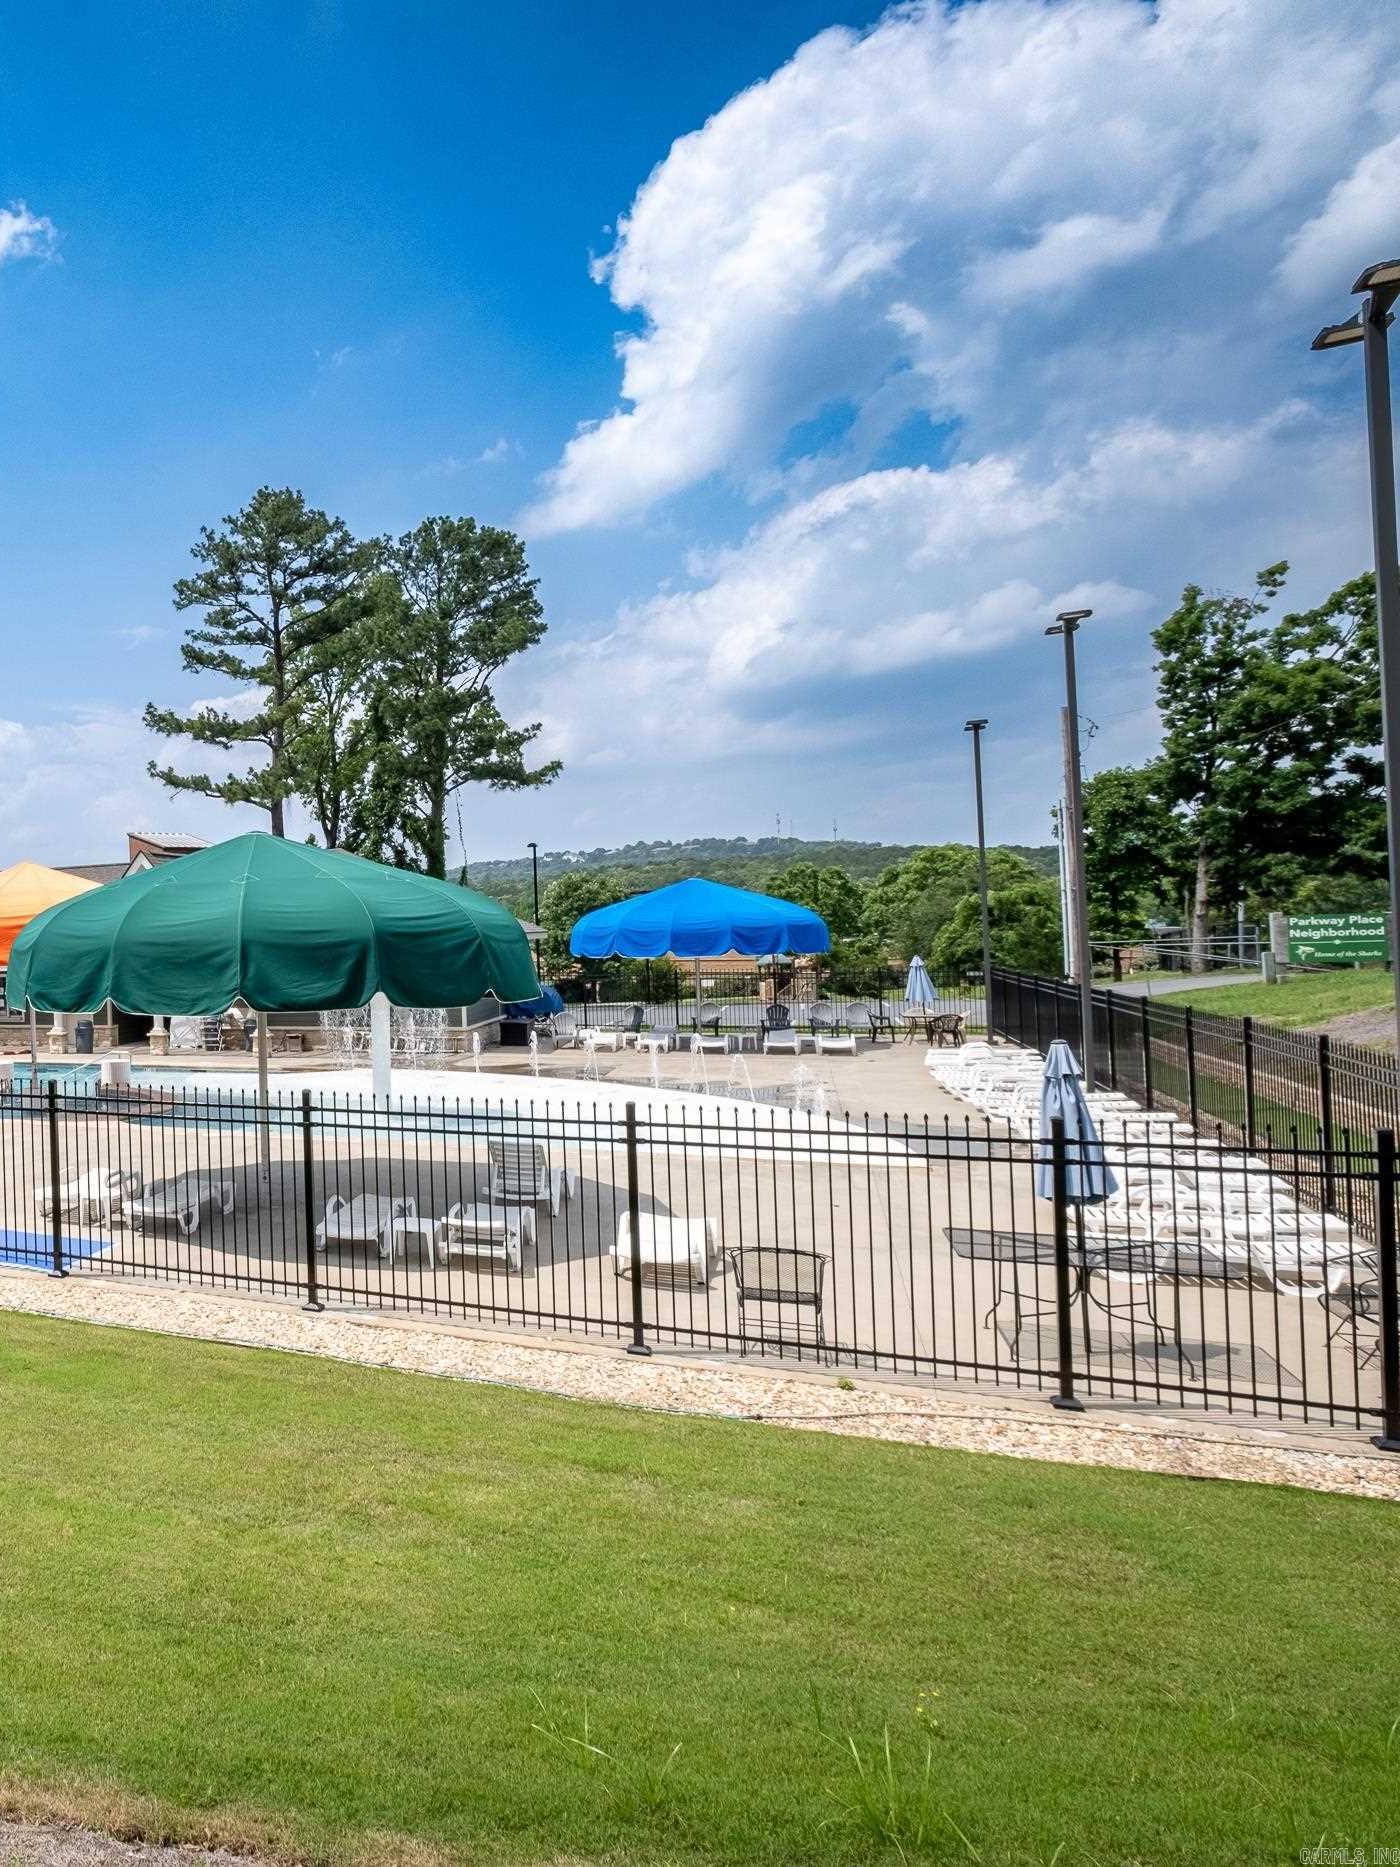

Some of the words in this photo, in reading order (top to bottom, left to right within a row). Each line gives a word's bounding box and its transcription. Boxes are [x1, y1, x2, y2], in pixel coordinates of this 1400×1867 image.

[1289, 917, 1345, 926] Parkway
[1349, 915, 1383, 924] Place
[1289, 927, 1385, 939] Neighborhood
